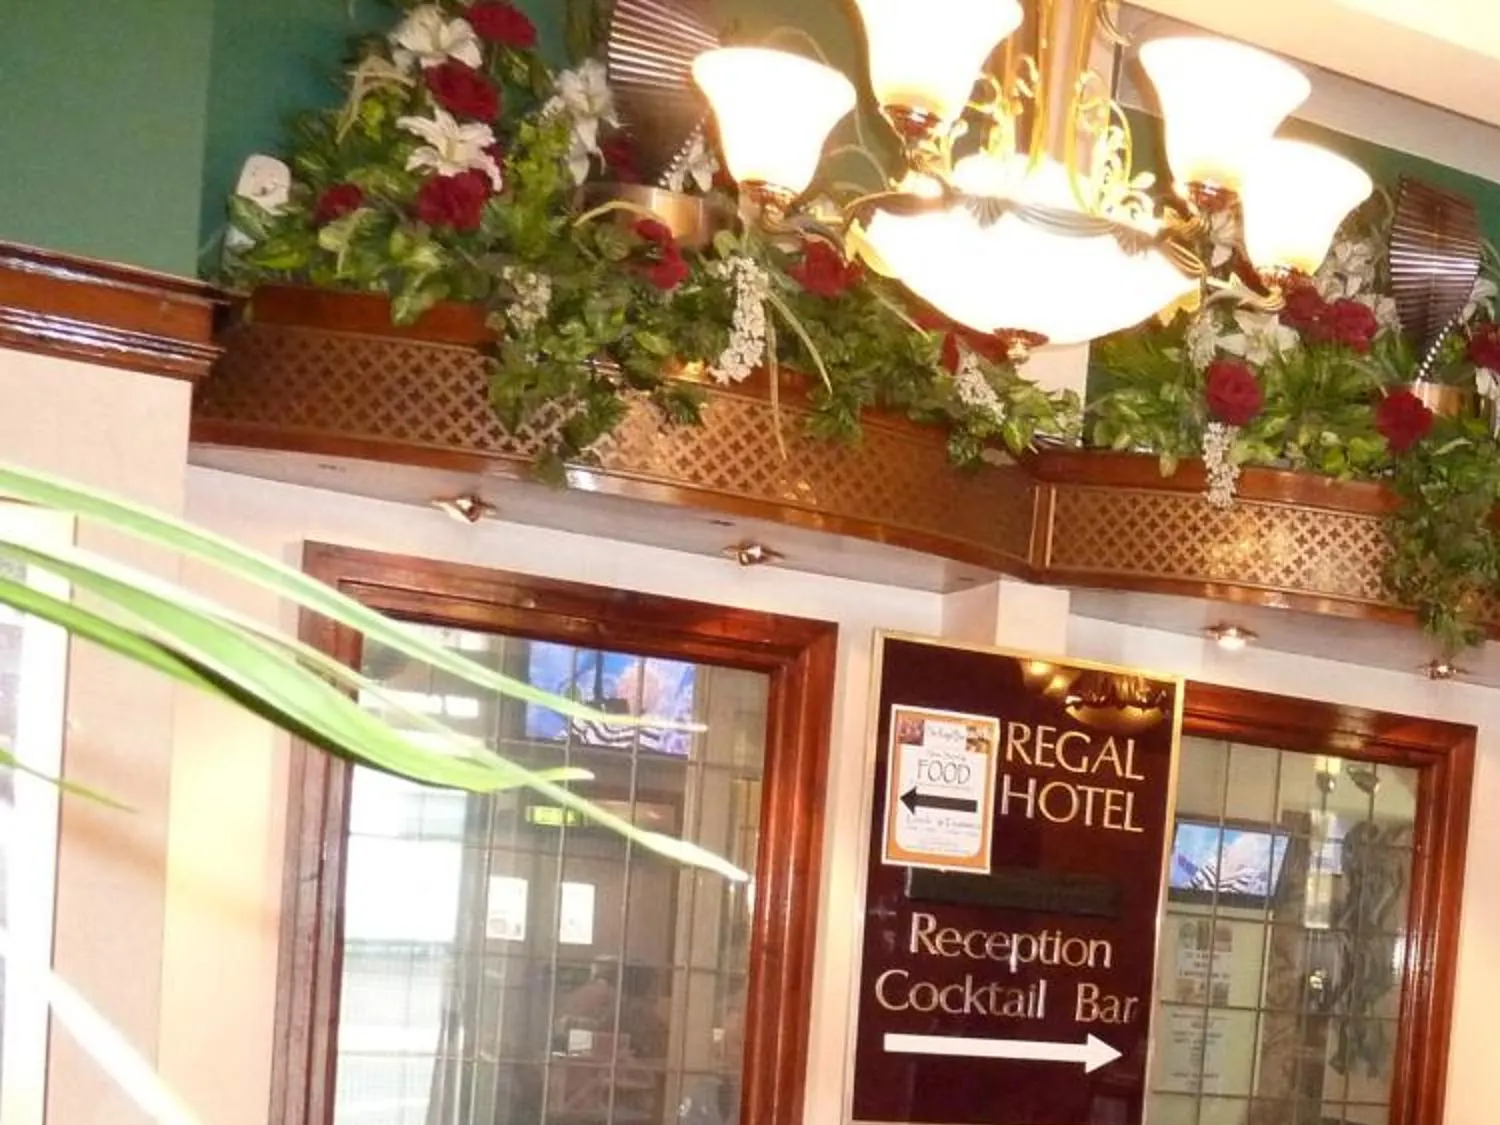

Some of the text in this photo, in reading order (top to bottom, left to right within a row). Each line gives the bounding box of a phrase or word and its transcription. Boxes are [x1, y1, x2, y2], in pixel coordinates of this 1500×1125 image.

[917, 759, 971, 785] FOOD
[1006, 721, 1145, 781] REGAL
[1000, 773, 1145, 833] HOTEL
[909, 911, 1112, 973] Reception
[875, 969, 1139, 1024] Cocktail Bar
